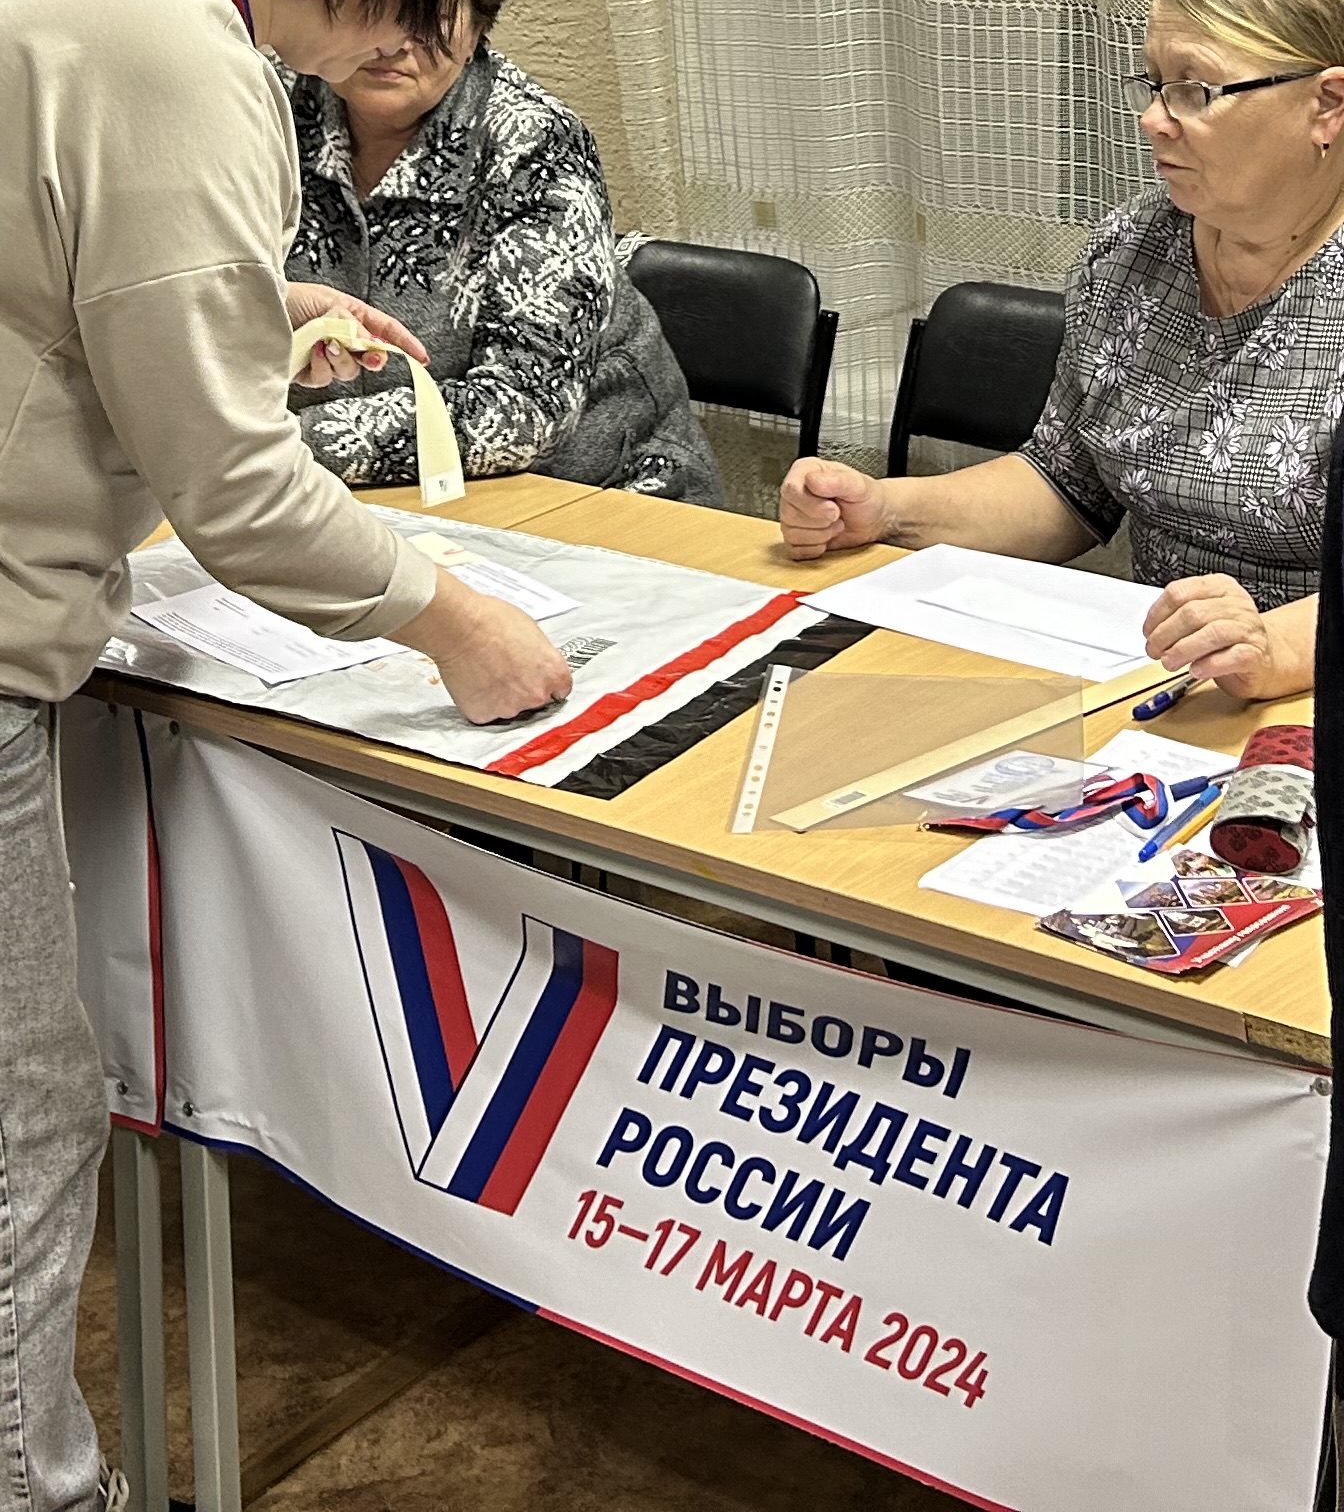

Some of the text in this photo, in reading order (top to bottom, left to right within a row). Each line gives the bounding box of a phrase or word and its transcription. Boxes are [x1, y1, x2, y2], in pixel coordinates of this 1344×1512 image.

[662, 969, 972, 1099] ВЫБОРЫ
[596, 1107, 872, 1262] РОССИИ
[636, 1023, 1070, 1247] ПРЕЗИДЕНТА
[694, 1239, 863, 1354] МАРТА
[863, 1312, 989, 1409] 2024
